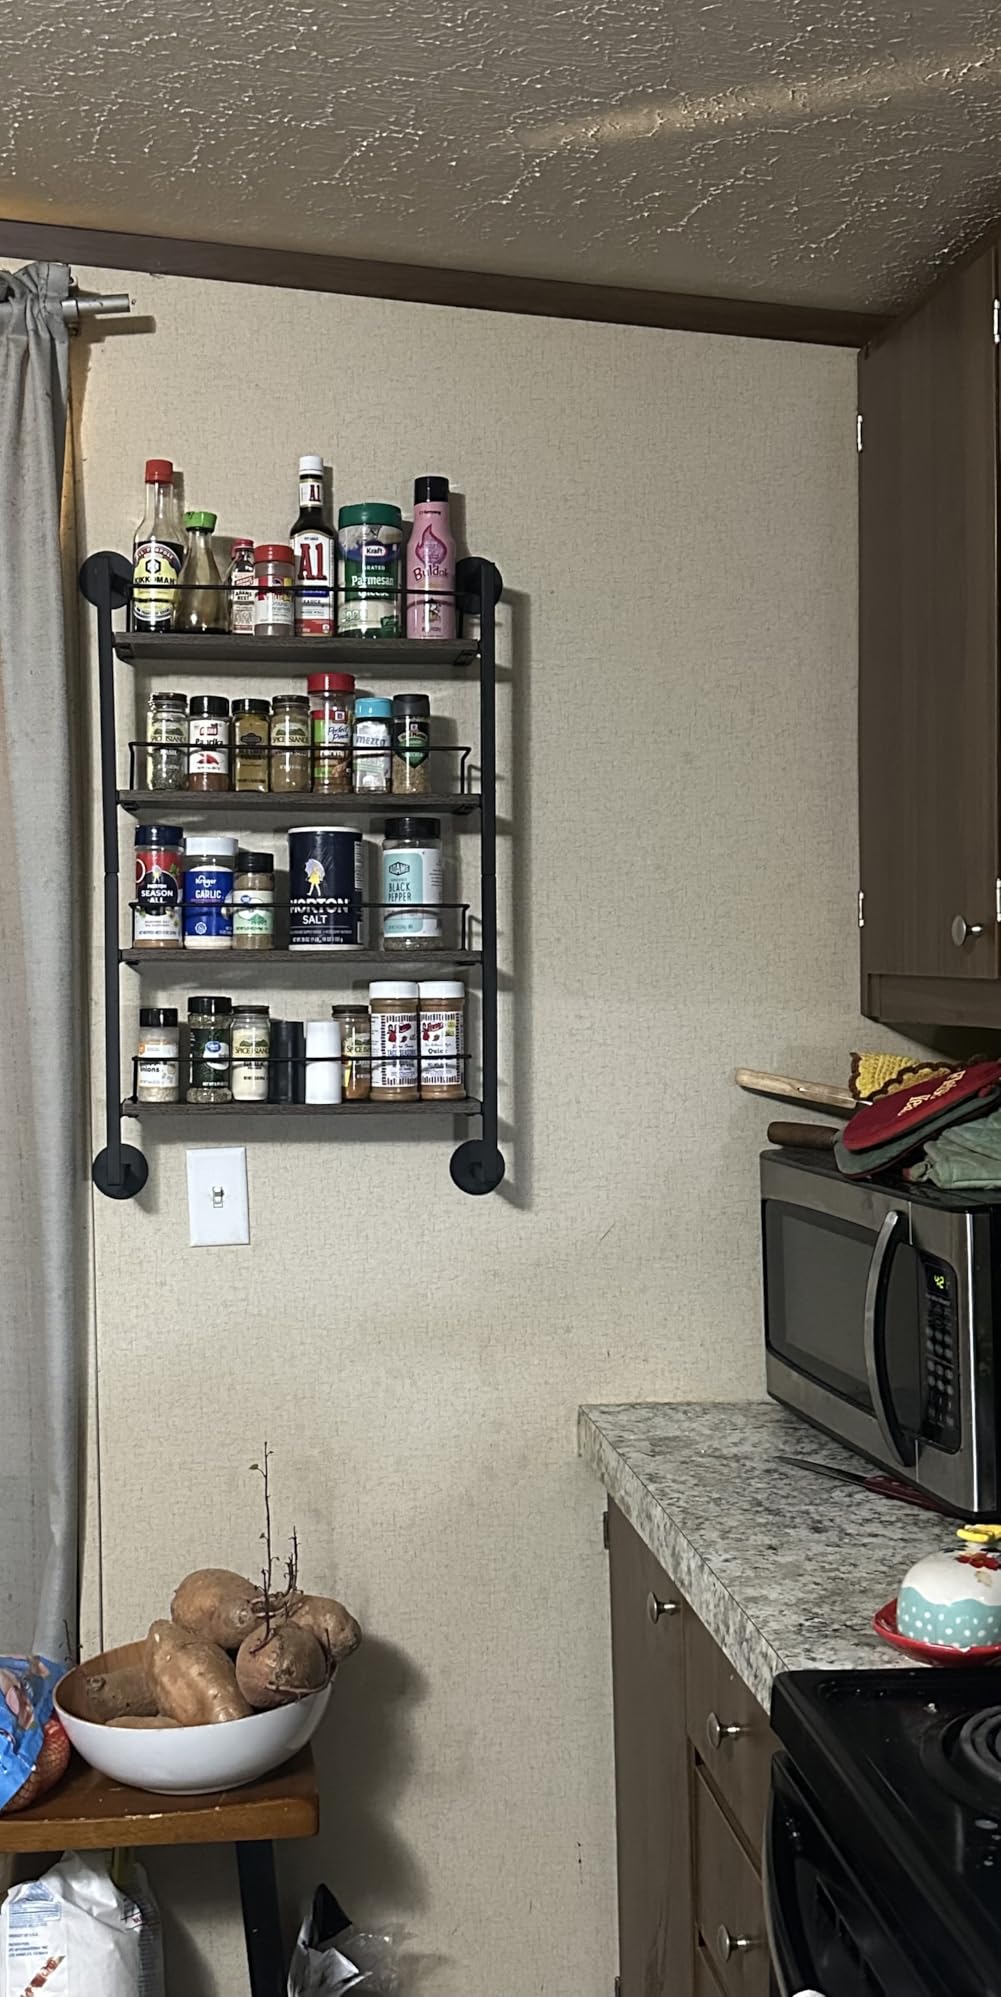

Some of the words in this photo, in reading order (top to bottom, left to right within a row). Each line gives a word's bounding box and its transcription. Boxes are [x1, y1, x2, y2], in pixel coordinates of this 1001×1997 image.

[298, 542, 328, 580] A1
[135, 576, 175, 585] KIKKMAN
[351, 575, 394, 586] Parmesan
[195, 875, 216, 888] Kroger
[389, 882, 410, 892] BLACK
[195, 890, 221, 899] GARLIC
[388, 892, 411, 902] PEPPER
[302, 915, 328, 924] SALT
